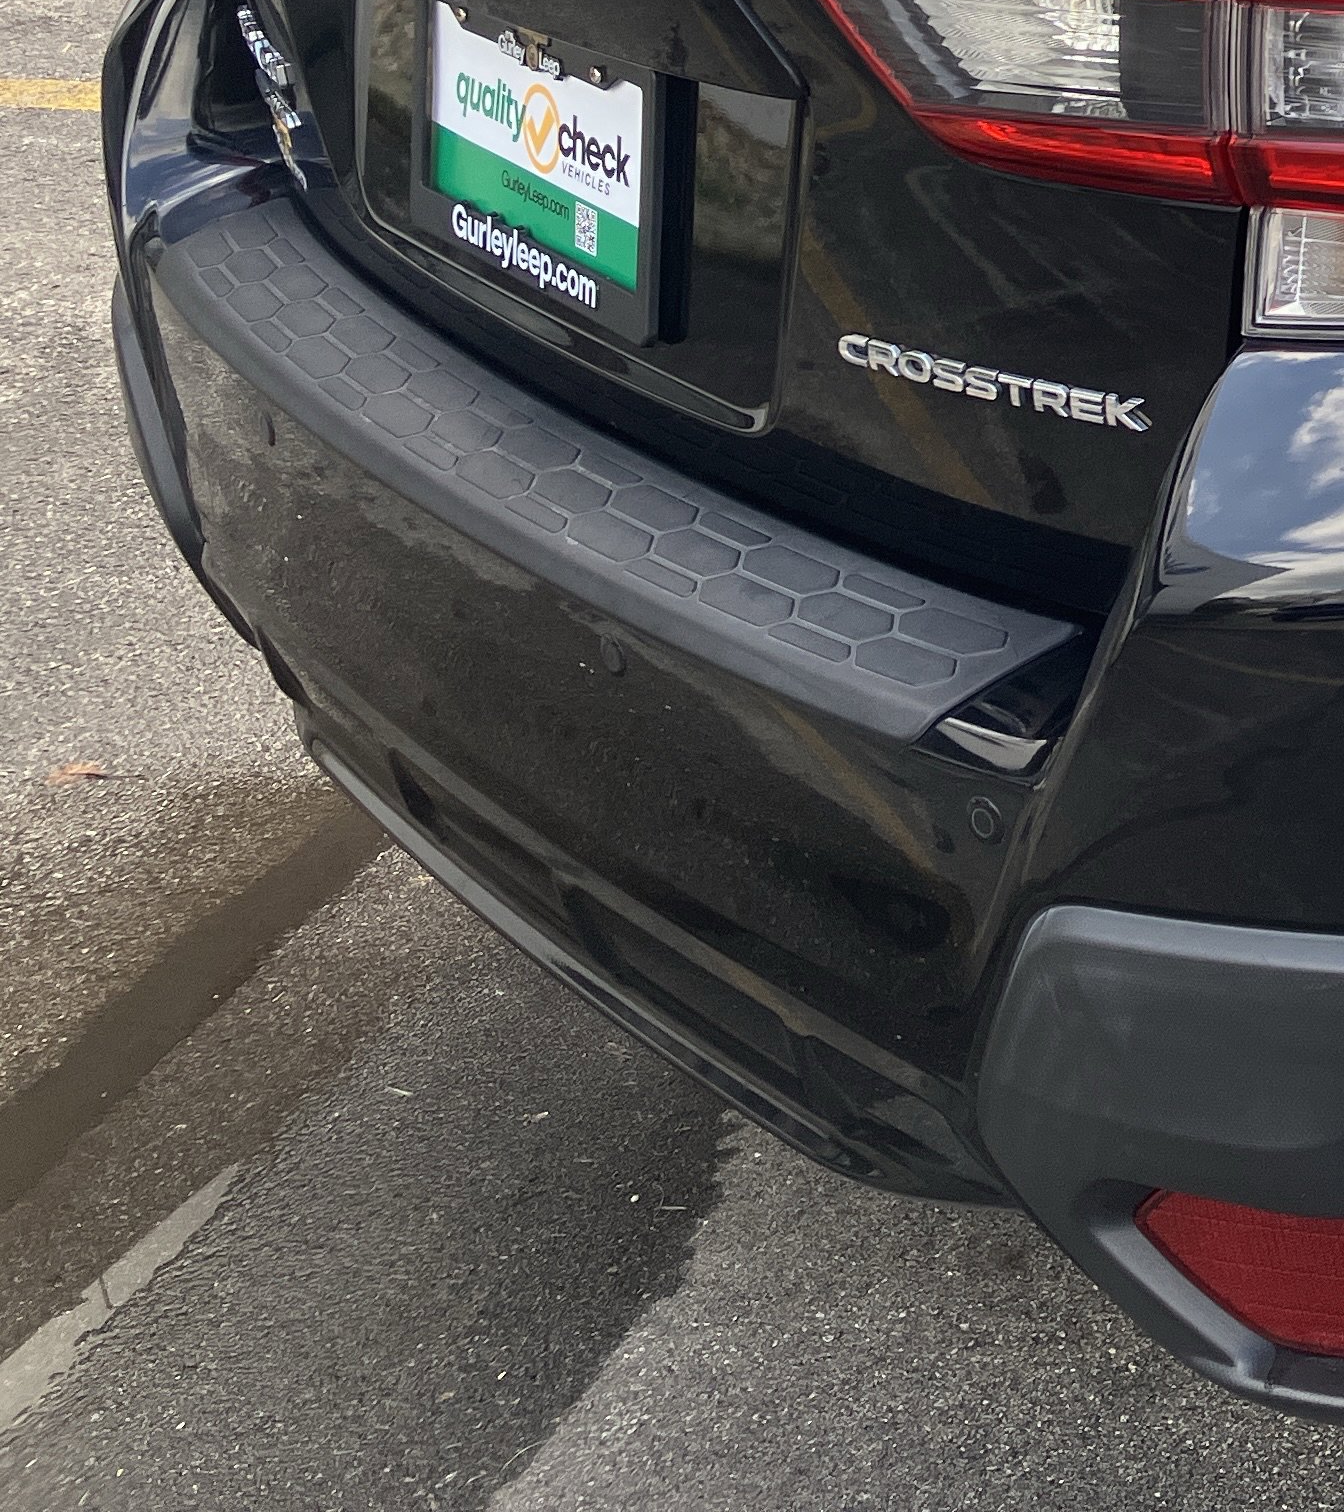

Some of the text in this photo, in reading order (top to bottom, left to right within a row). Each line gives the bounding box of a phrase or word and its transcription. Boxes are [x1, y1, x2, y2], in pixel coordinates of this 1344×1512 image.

[456, 71, 631, 187] quality check
[561, 160, 611, 196] VEHICLES
[452, 203, 598, 308] Gurleyleep.com
[838, 333, 1152, 432] CROSSTREK
